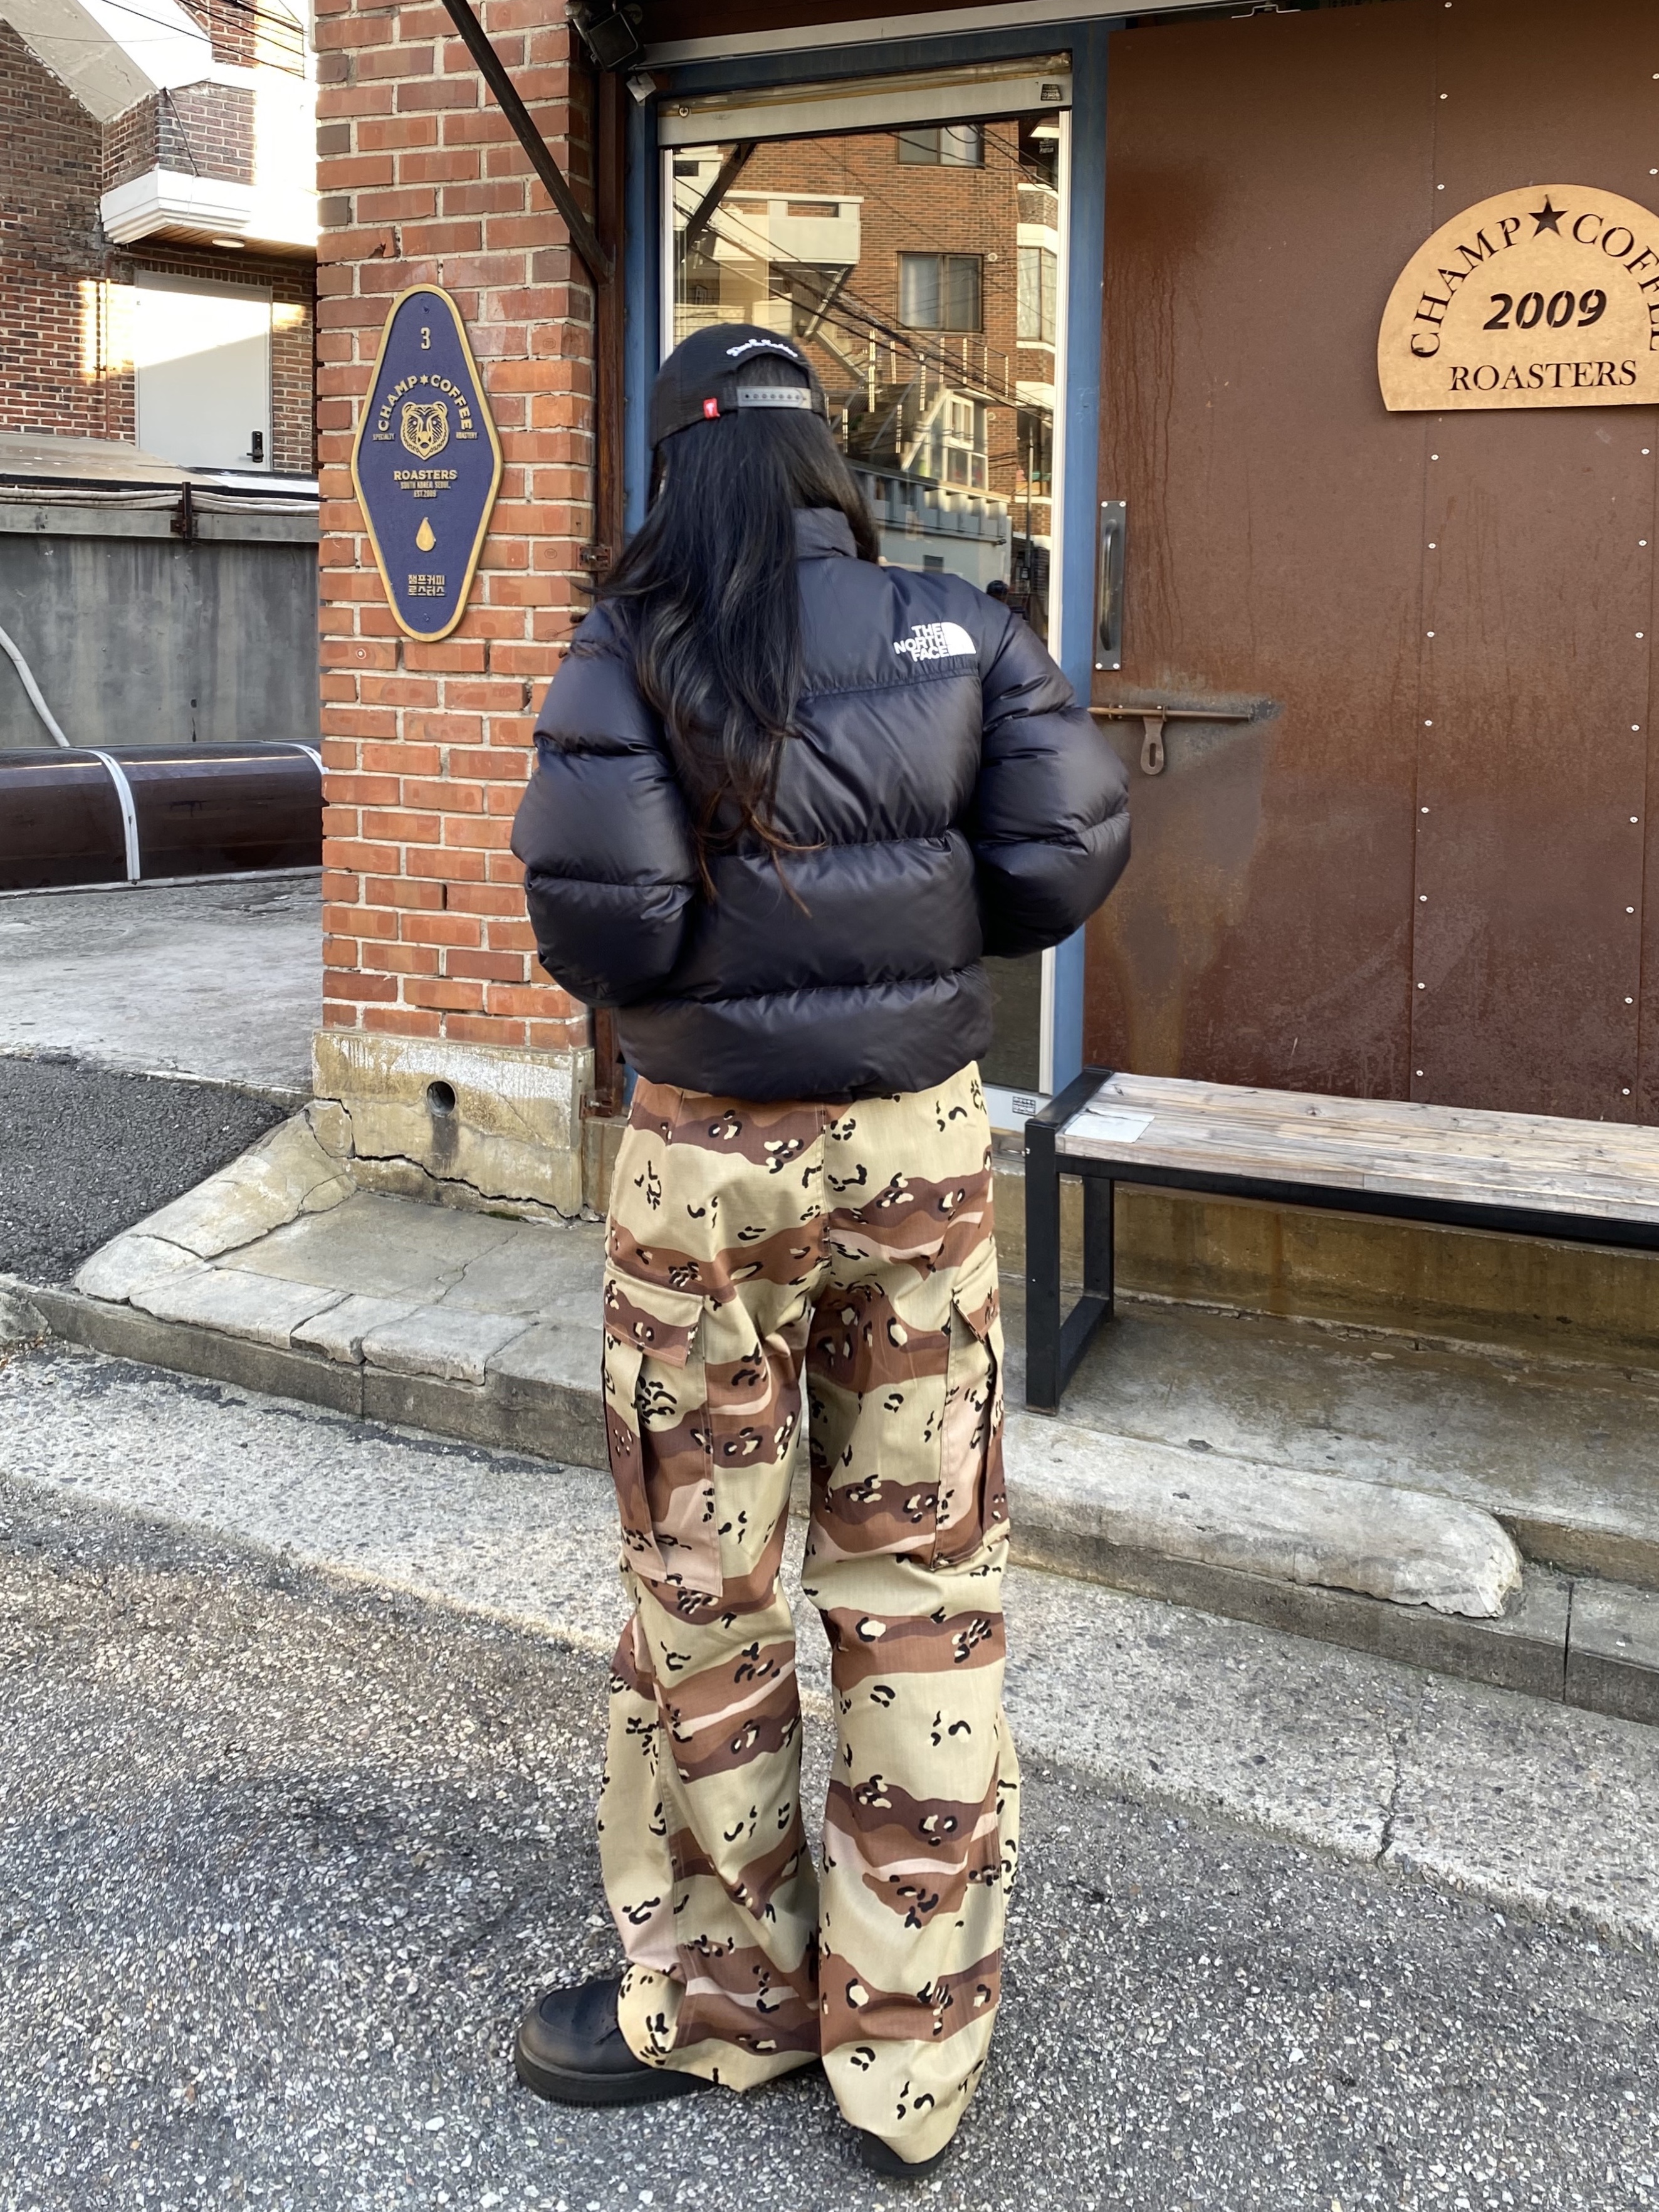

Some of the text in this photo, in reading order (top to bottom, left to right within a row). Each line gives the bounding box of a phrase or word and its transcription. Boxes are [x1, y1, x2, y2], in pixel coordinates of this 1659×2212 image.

[1411, 217, 1521, 358] CHAMP
[1483, 289, 1607, 330] 2009
[421, 327, 431, 350] 3
[1448, 360, 1637, 391] ROASTERS
[378, 374, 473, 431] CHAMP COFFEE
[394, 470, 458, 481] ROASTERS
[408, 585, 446, 596] 로스터스
[911, 622, 943, 637] THE
[893, 631, 946, 654] NORTH
[911, 645, 950, 662] FACE
